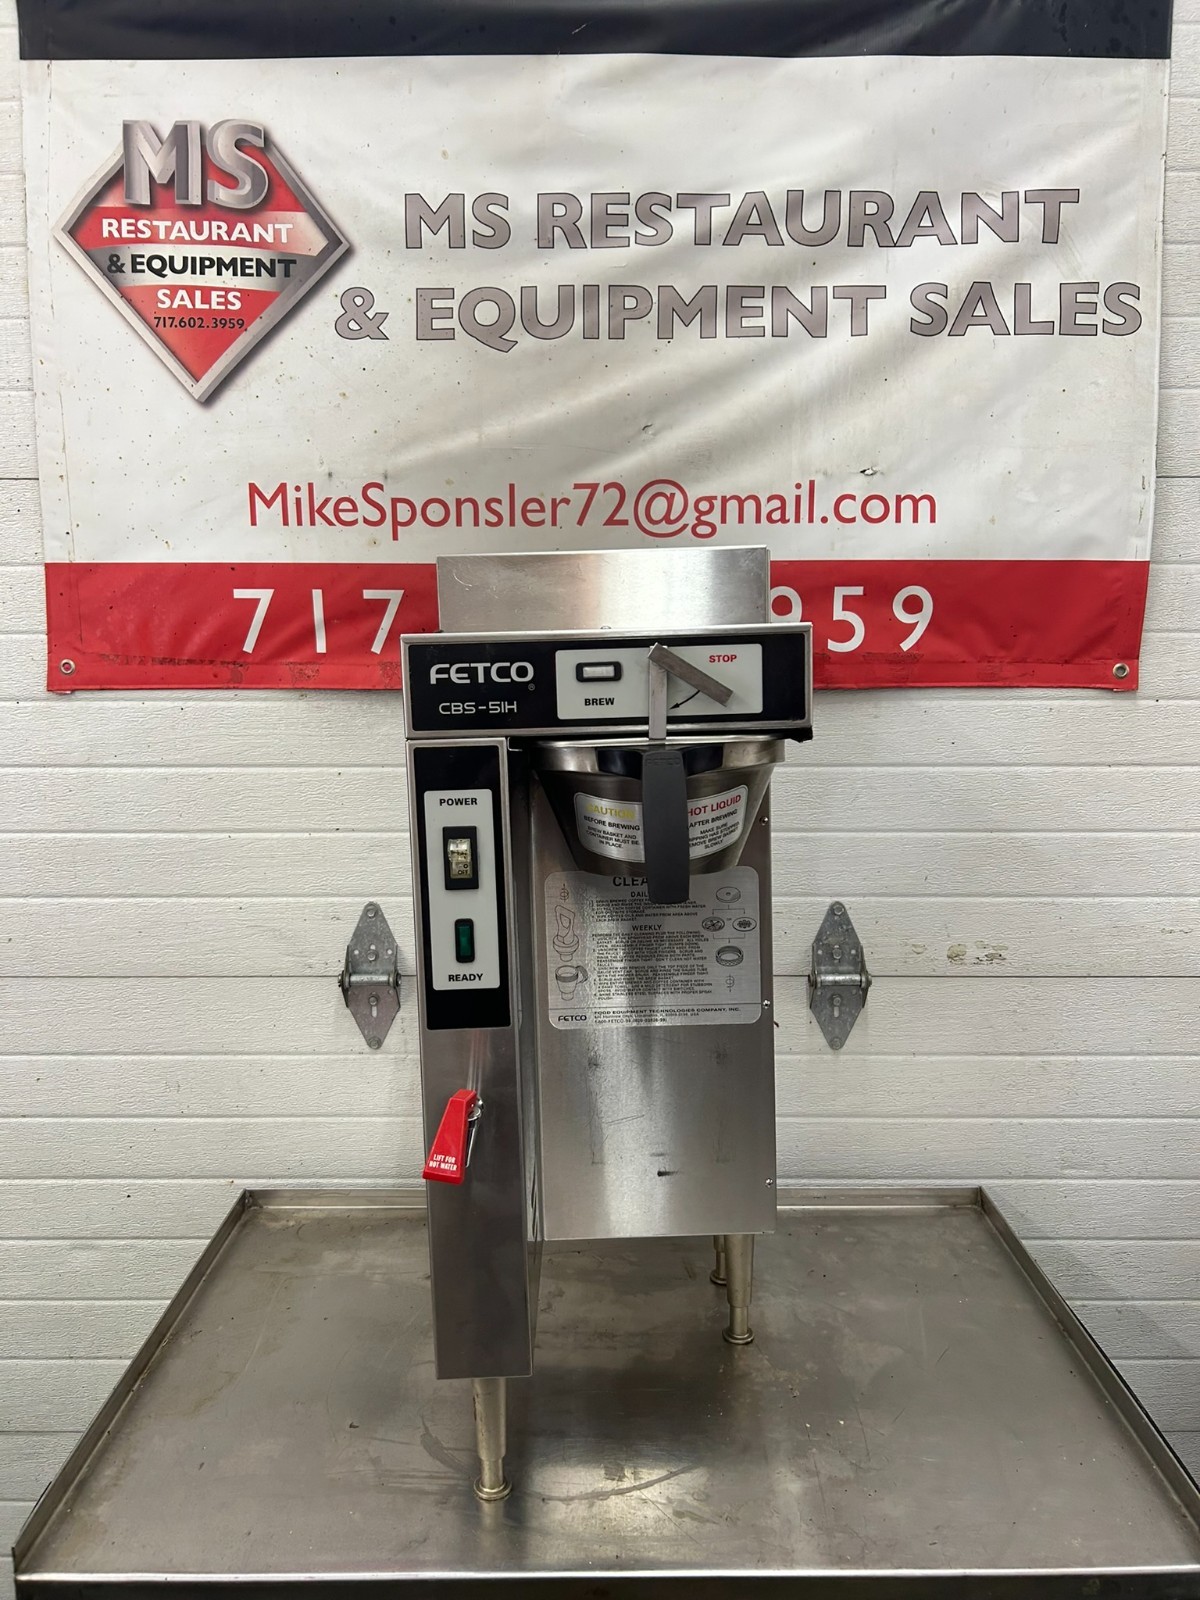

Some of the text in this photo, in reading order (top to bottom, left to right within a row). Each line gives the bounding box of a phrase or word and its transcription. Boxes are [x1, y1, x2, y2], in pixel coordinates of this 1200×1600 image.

[121, 118, 270, 210] MS
[404, 188, 1080, 251] MS RESTAURANT
[101, 217, 295, 245] RESTAURANT
[106, 254, 298, 278] & EQUIPMENT
[156, 288, 243, 312] SALES
[152, 314, 247, 330] 717.602.3959
[333, 280, 1143, 353] & EQUIPMENT SALES
[248, 477, 938, 543] MikeSponsler72@gmail.com
[709, 654, 737, 663] STOP
[430, 661, 535, 685] FETCO
[584, 697, 615, 706] BREW
[439, 797, 478, 807] POWER
[711, 794, 742, 812] LIQUID
[586, 803, 636, 821] CAUTION
[689, 809, 739, 829] AFTER BREWING
[583, 815, 641, 832] BEFORE BREWING
[700, 826, 715, 836] MAKE
[586, 830, 614, 842] CONTAINER
[614, 837, 631, 845] MUST
[603, 830, 624, 839] BASKET
[624, 833, 637, 841] AND
[709, 829, 720, 838] HAS
[448, 973, 484, 982] READY
[557, 1014, 587, 1022] FETCO
[440, 1163, 457, 1171] WATER
